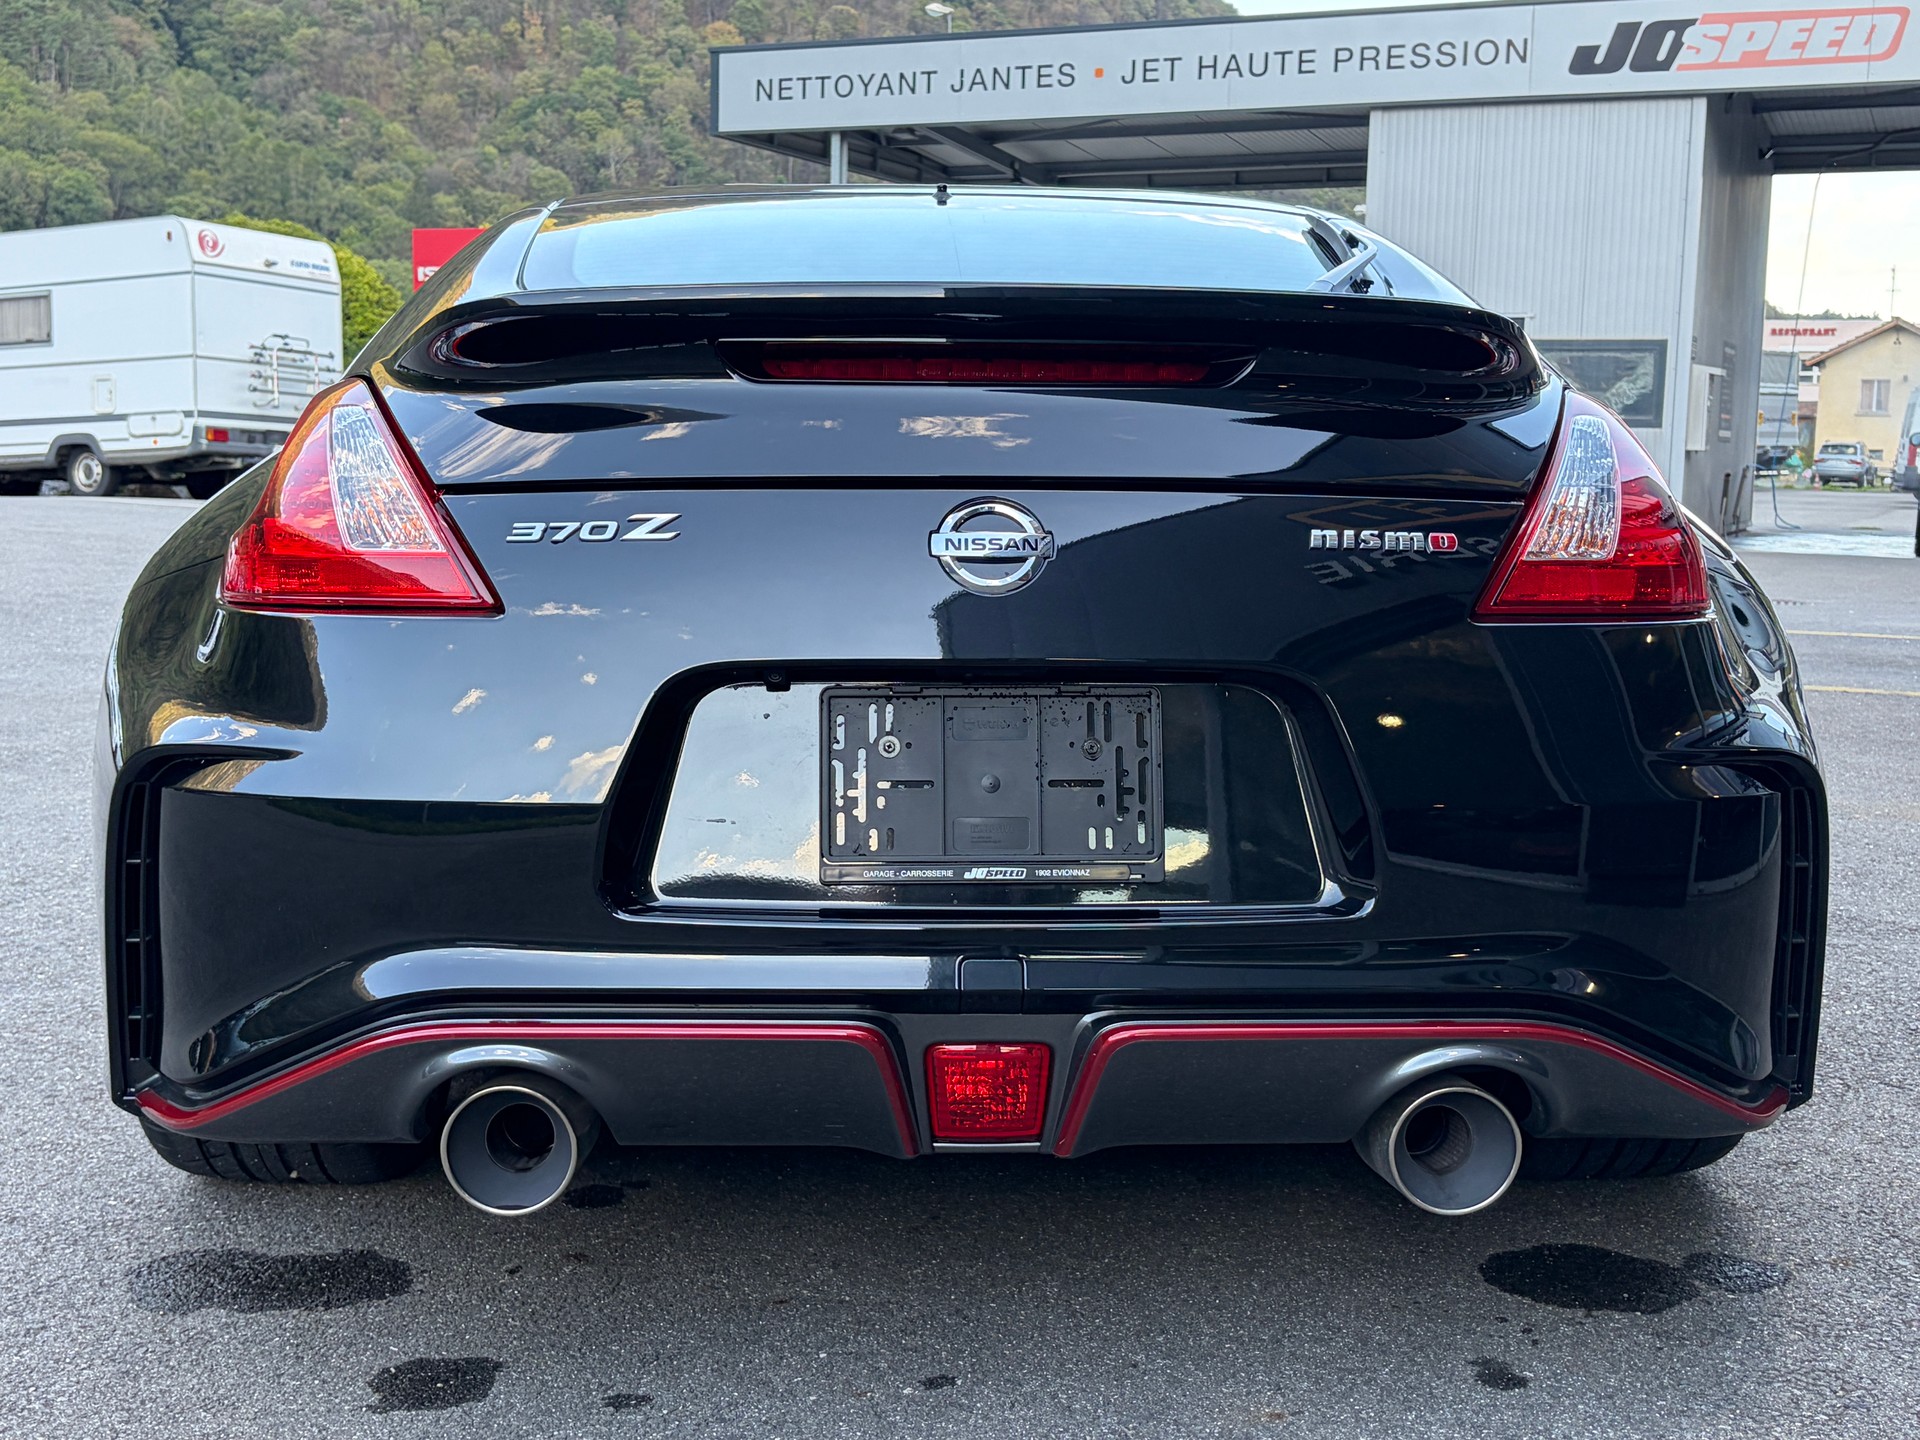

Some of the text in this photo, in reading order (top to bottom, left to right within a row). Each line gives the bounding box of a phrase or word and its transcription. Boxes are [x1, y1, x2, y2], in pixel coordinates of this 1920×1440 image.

[755, 37, 1529, 102] NETTOYANT JANTES JET HAUTE PRESSION
[1770, 327, 1838, 337] RESTAURANT
[944, 538, 1039, 551] NISSAN
[863, 870, 895, 878] GARAGE
[900, 869, 954, 878] CARROSSERIE
[1034, 869, 1051, 877] 1902
[1053, 869, 1091, 877] EVIONNAZ
